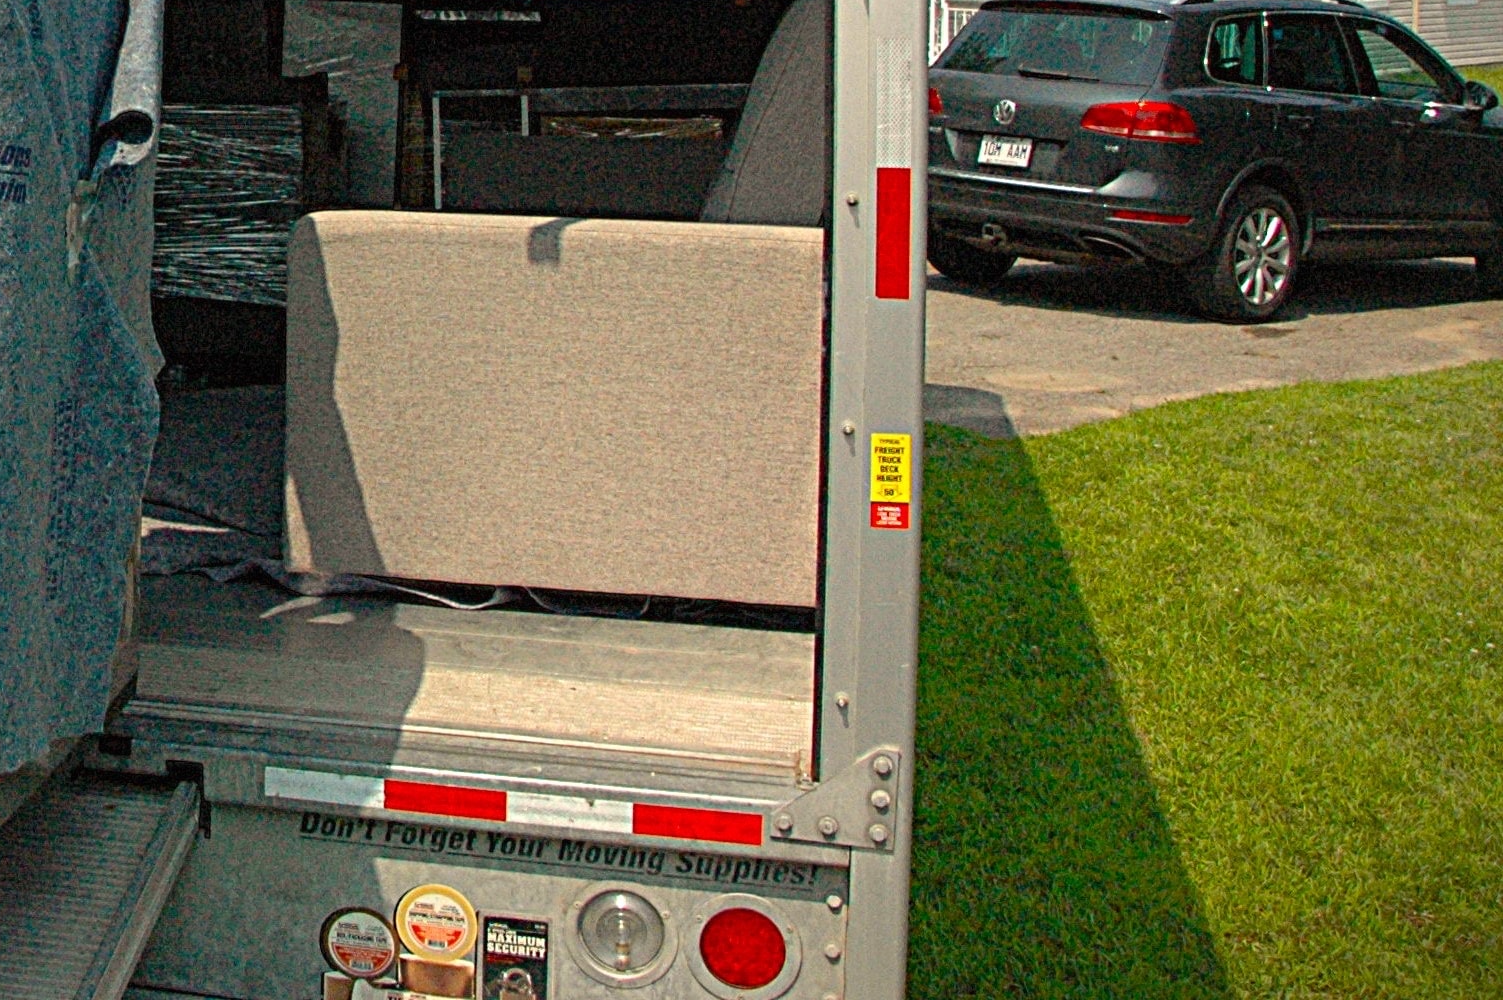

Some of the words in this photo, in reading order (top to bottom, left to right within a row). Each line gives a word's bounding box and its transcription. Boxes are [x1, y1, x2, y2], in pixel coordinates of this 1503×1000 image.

[874, 446, 905, 454] FREIGHT
[877, 455, 902, 464] TRUCK
[300, 812, 376, 840] Don't
[384, 820, 481, 853] Forget
[486, 831, 550, 858] Your
[558, 839, 666, 875] Moving
[675, 852, 820, 886] Supplies!
[487, 932, 545, 948] MAXIMUM
[487, 942, 545, 958] SECURITY
